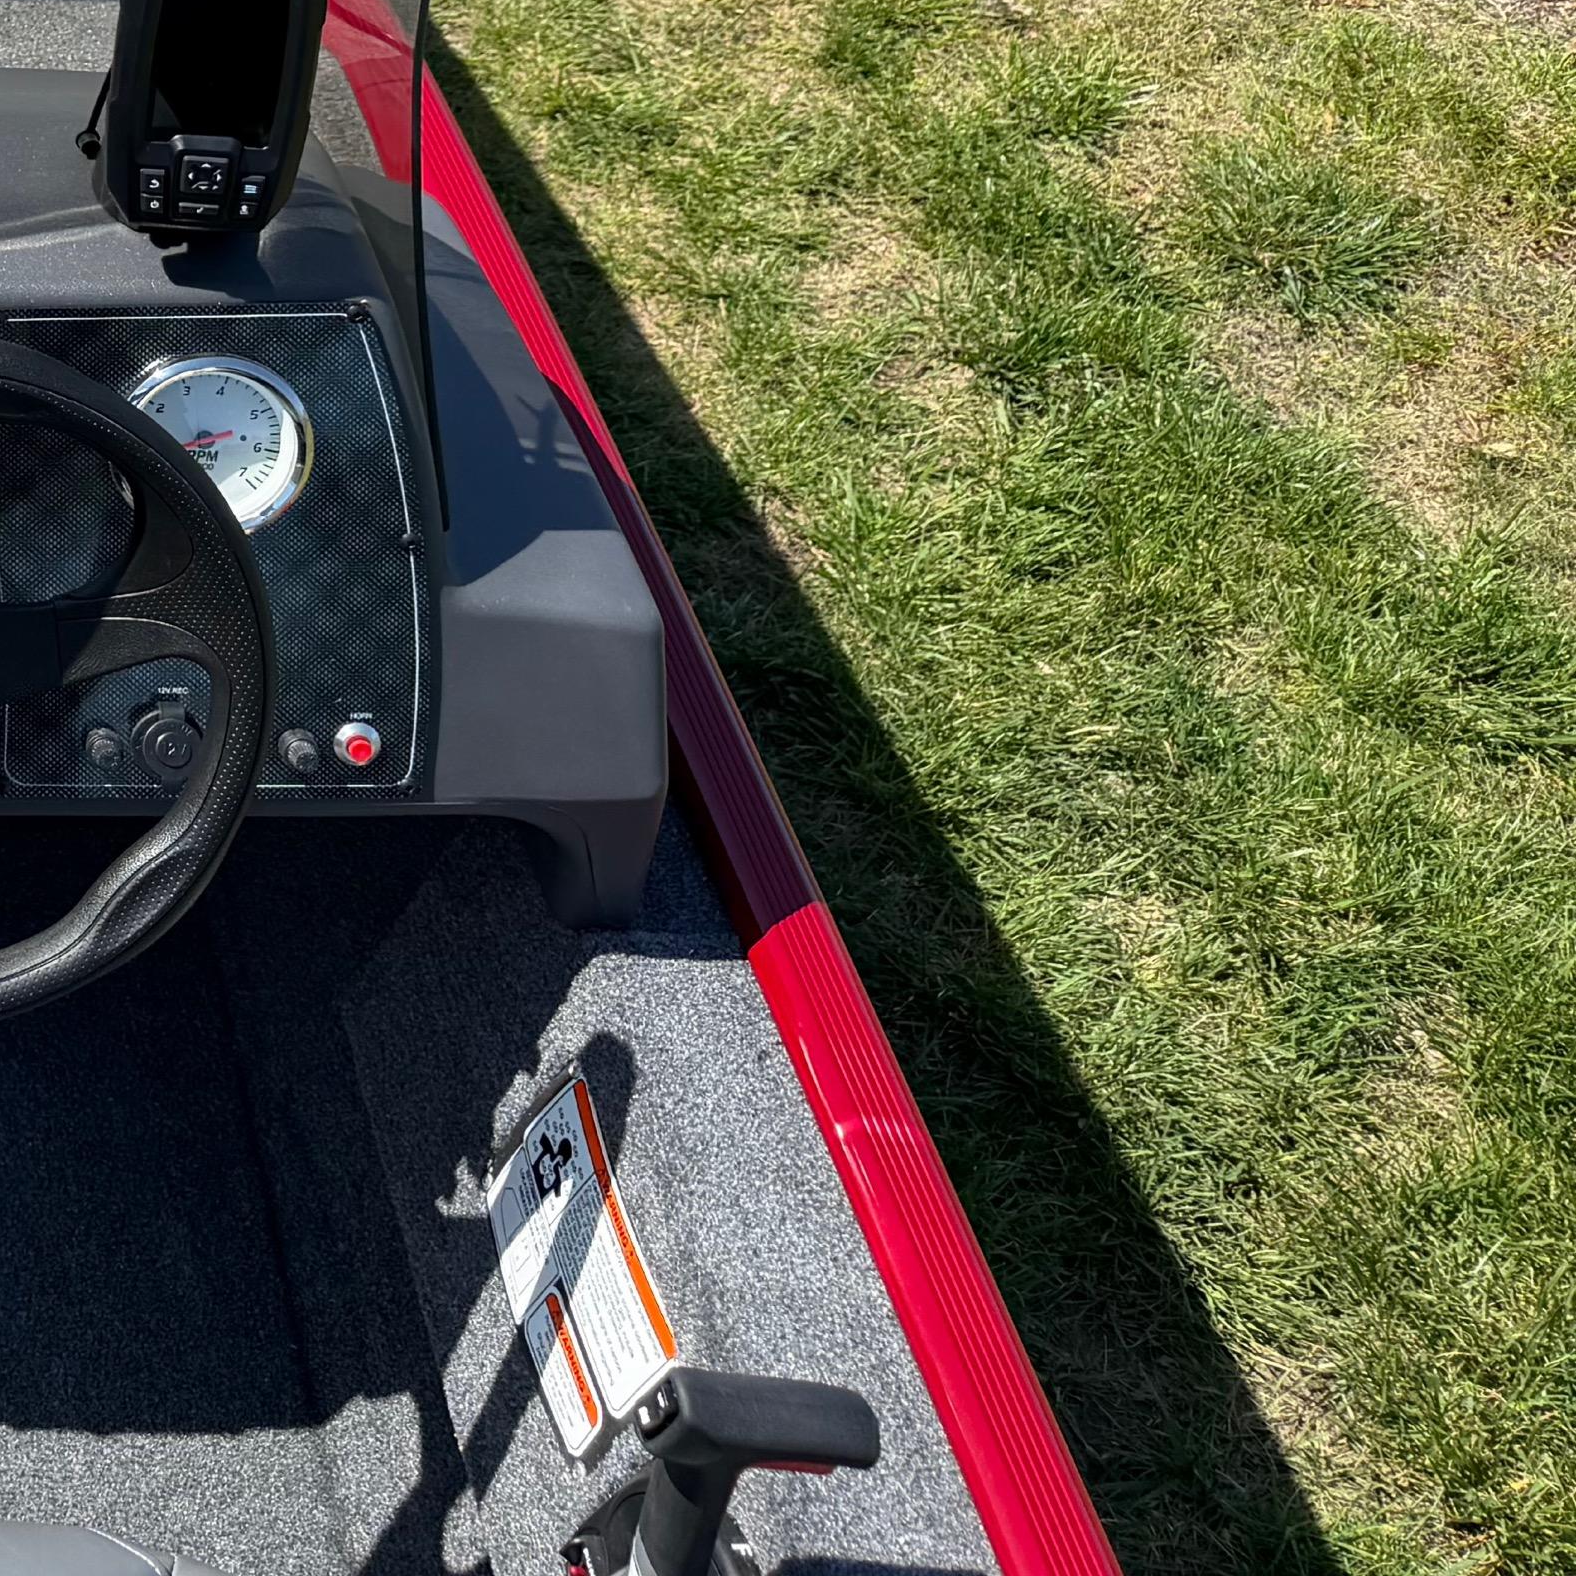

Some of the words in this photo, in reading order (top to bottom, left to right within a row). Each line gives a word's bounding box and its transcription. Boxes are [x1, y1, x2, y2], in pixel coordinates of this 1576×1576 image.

[183, 386, 191, 396] 3
[216, 386, 225, 396] 4
[155, 403, 165, 413] 2
[250, 410, 259, 420] 5
[253, 442, 262, 453] 6
[239, 467, 247, 477] 7
